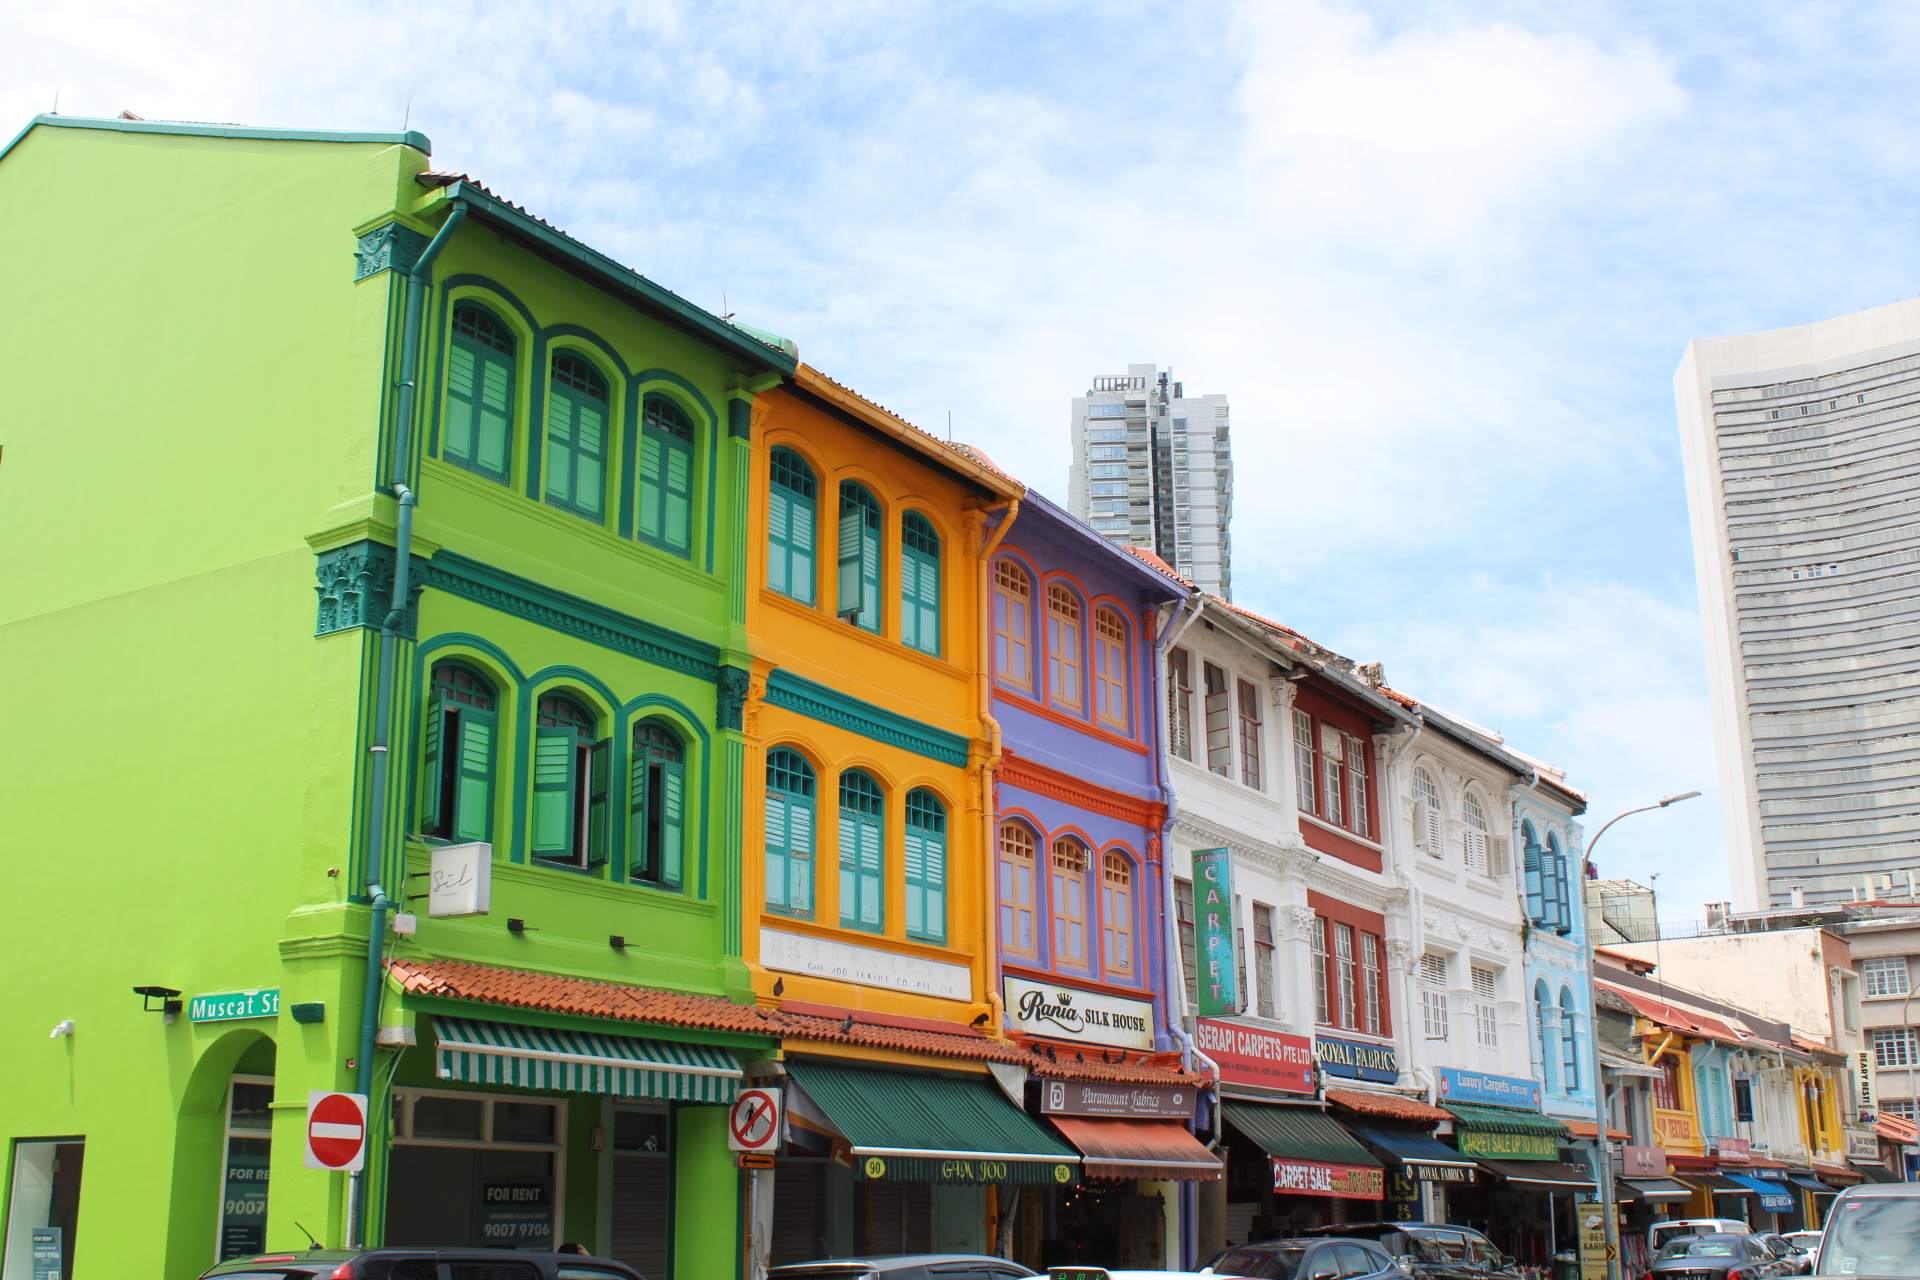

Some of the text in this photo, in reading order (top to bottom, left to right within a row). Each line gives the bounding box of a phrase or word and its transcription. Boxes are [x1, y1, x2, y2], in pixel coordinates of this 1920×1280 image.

[1195, 852, 1226, 863] SERAPI
[1205, 865, 1221, 1000] CARPET
[192, 993, 280, 1018] Muscat St
[1018, 990, 1145, 1031] Rania SILK HOUSE
[1198, 1024, 1310, 1065] SERAPI CARPETS PTE LTD
[1316, 1041, 1397, 1071] ROYAL FABRICS
[1860, 1052, 1868, 1080] BEARY
[1457, 1071, 1482, 1092] Luxury
[1483, 1075, 1509, 1095] Carpets
[1082, 1087, 1160, 1109] Paramount Fabrics
[1668, 1119, 1691, 1139] TEXTILES
[1461, 1132, 1490, 1152] CARPET
[1492, 1134, 1511, 1153] SALE
[1511, 1135, 1520, 1153] UP
[1521, 1136, 1530, 1153] TO
[1543, 1136, 1555, 1155] OFF
[229, 1168, 253, 1179] FOR
[870, 1161, 880, 1174] 90
[979, 1162, 1007, 1182] JOO
[1057, 1167, 1067, 1180] 90
[1418, 1166, 1464, 1181] ROYAL FABRICS
[1274, 1163, 1309, 1189] CARPET
[1309, 1166, 1332, 1191] SALE
[1346, 1169, 1365, 1195] 70%
[1366, 1170, 1383, 1195] OFF
[487, 1188, 541, 1201] FOR RENT
[226, 1200, 265, 1215] 9007
[484, 1223, 550, 1237] 9007 9706
